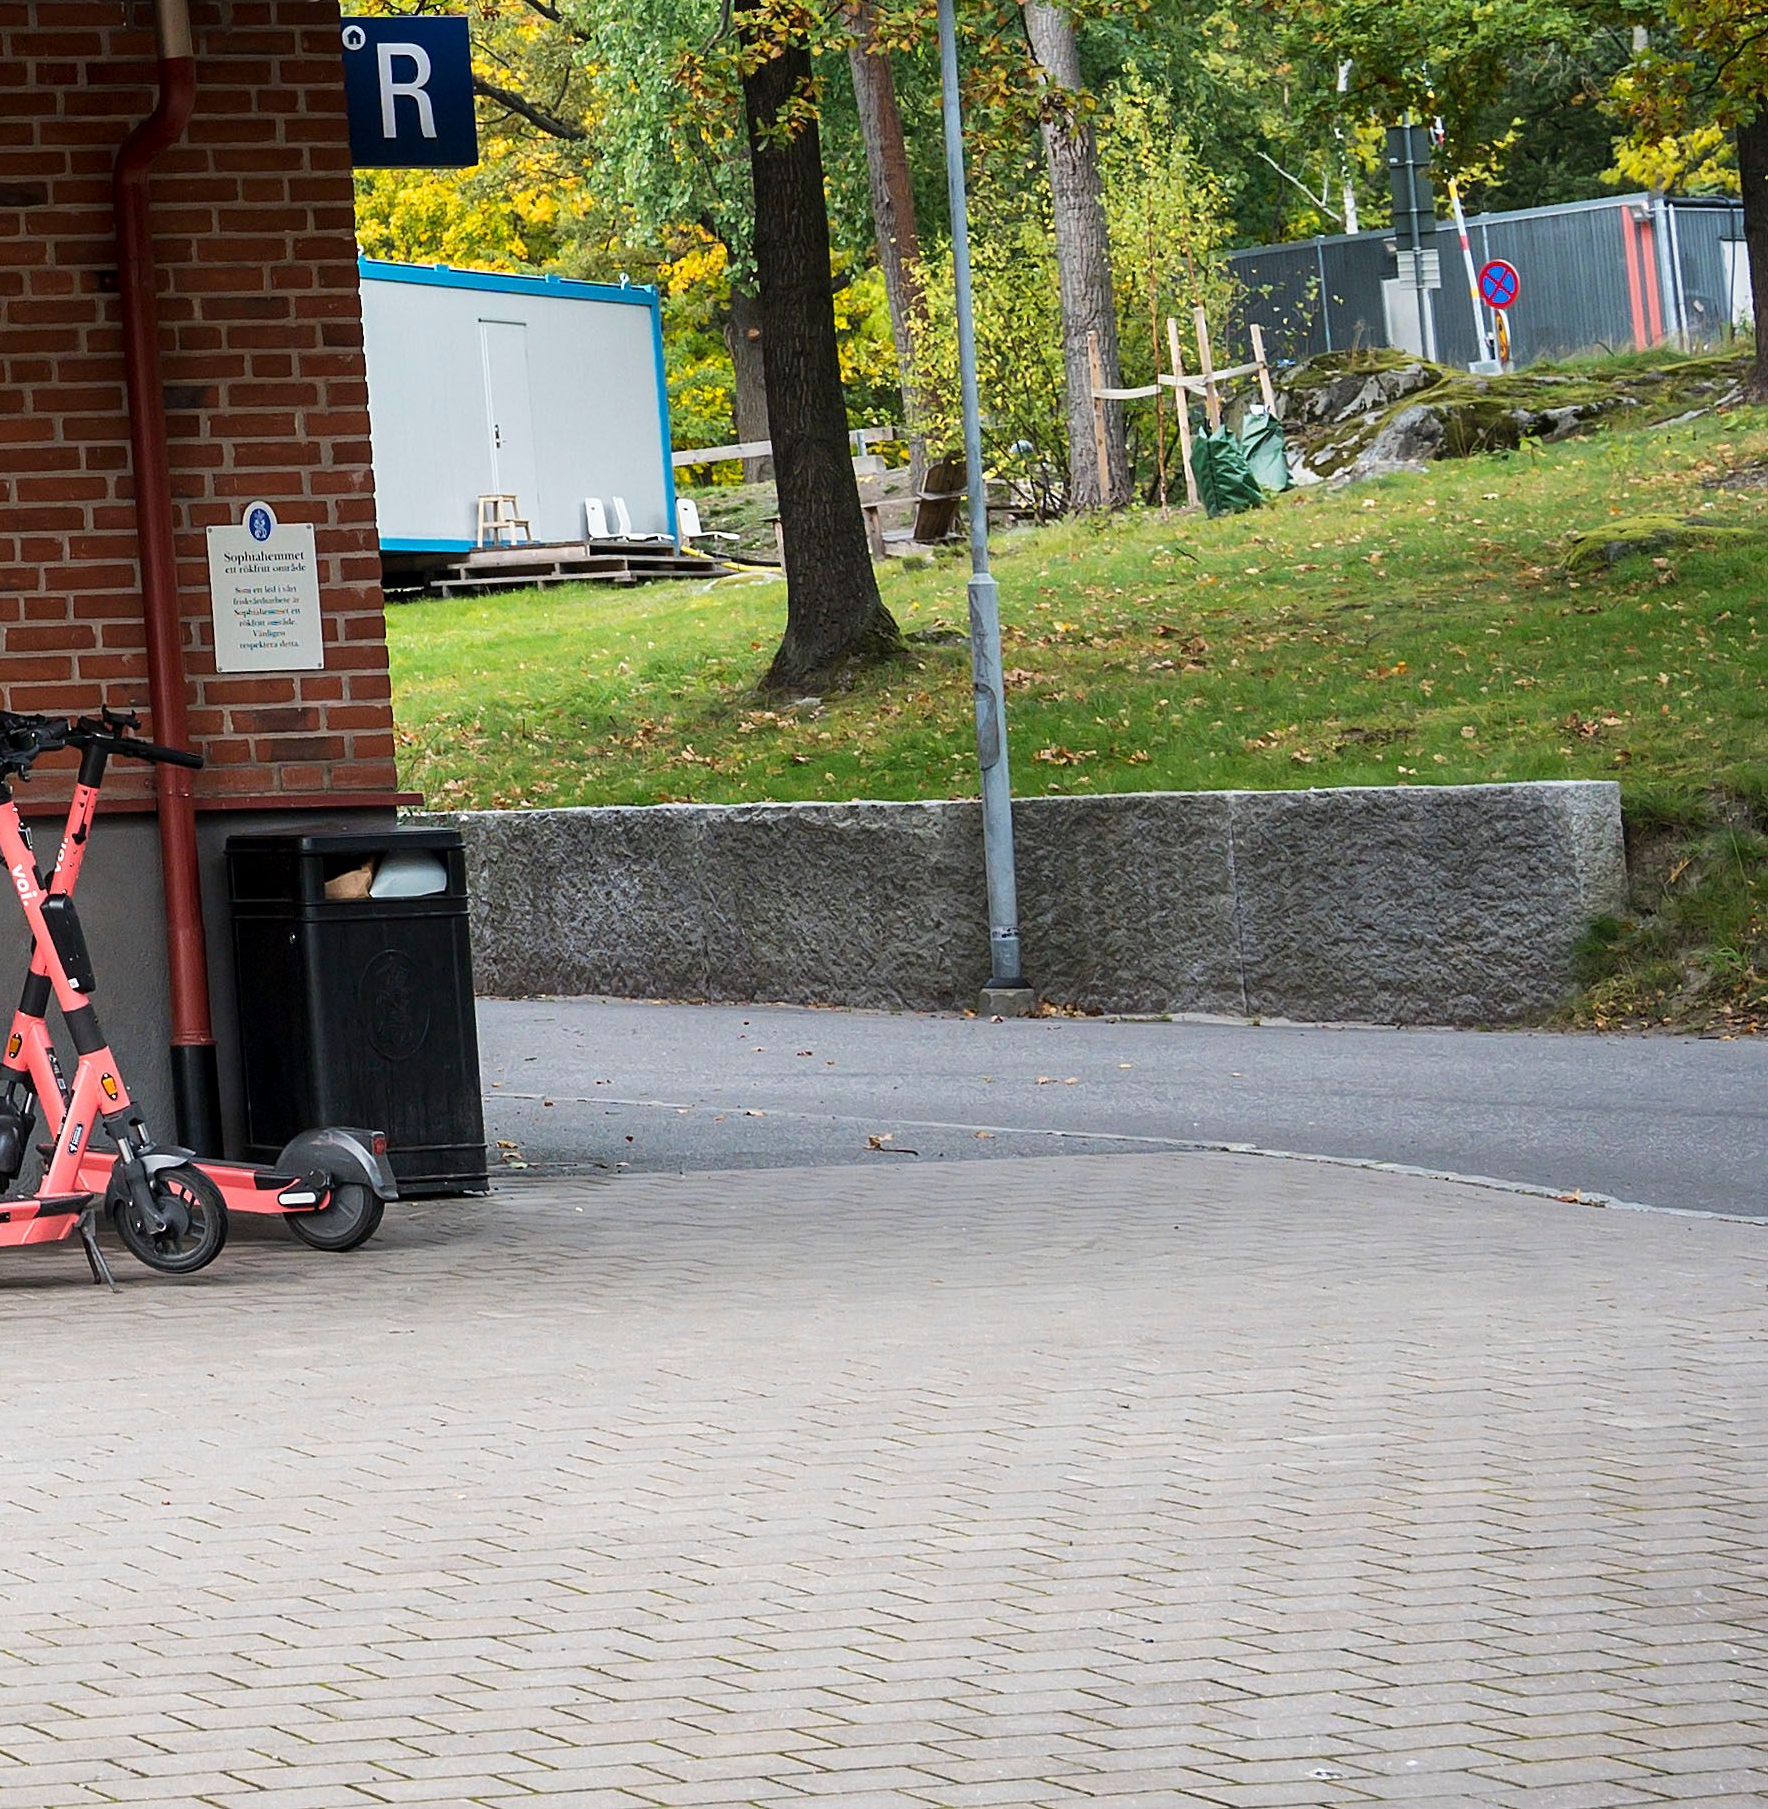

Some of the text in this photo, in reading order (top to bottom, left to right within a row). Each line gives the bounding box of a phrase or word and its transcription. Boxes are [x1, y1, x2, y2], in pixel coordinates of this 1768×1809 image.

[376, 41, 438, 140] R
[223, 551, 304, 565] Sophiahemmet
[225, 562, 306, 574] ett rökfritt område
[11, 863, 38, 907] voi.
